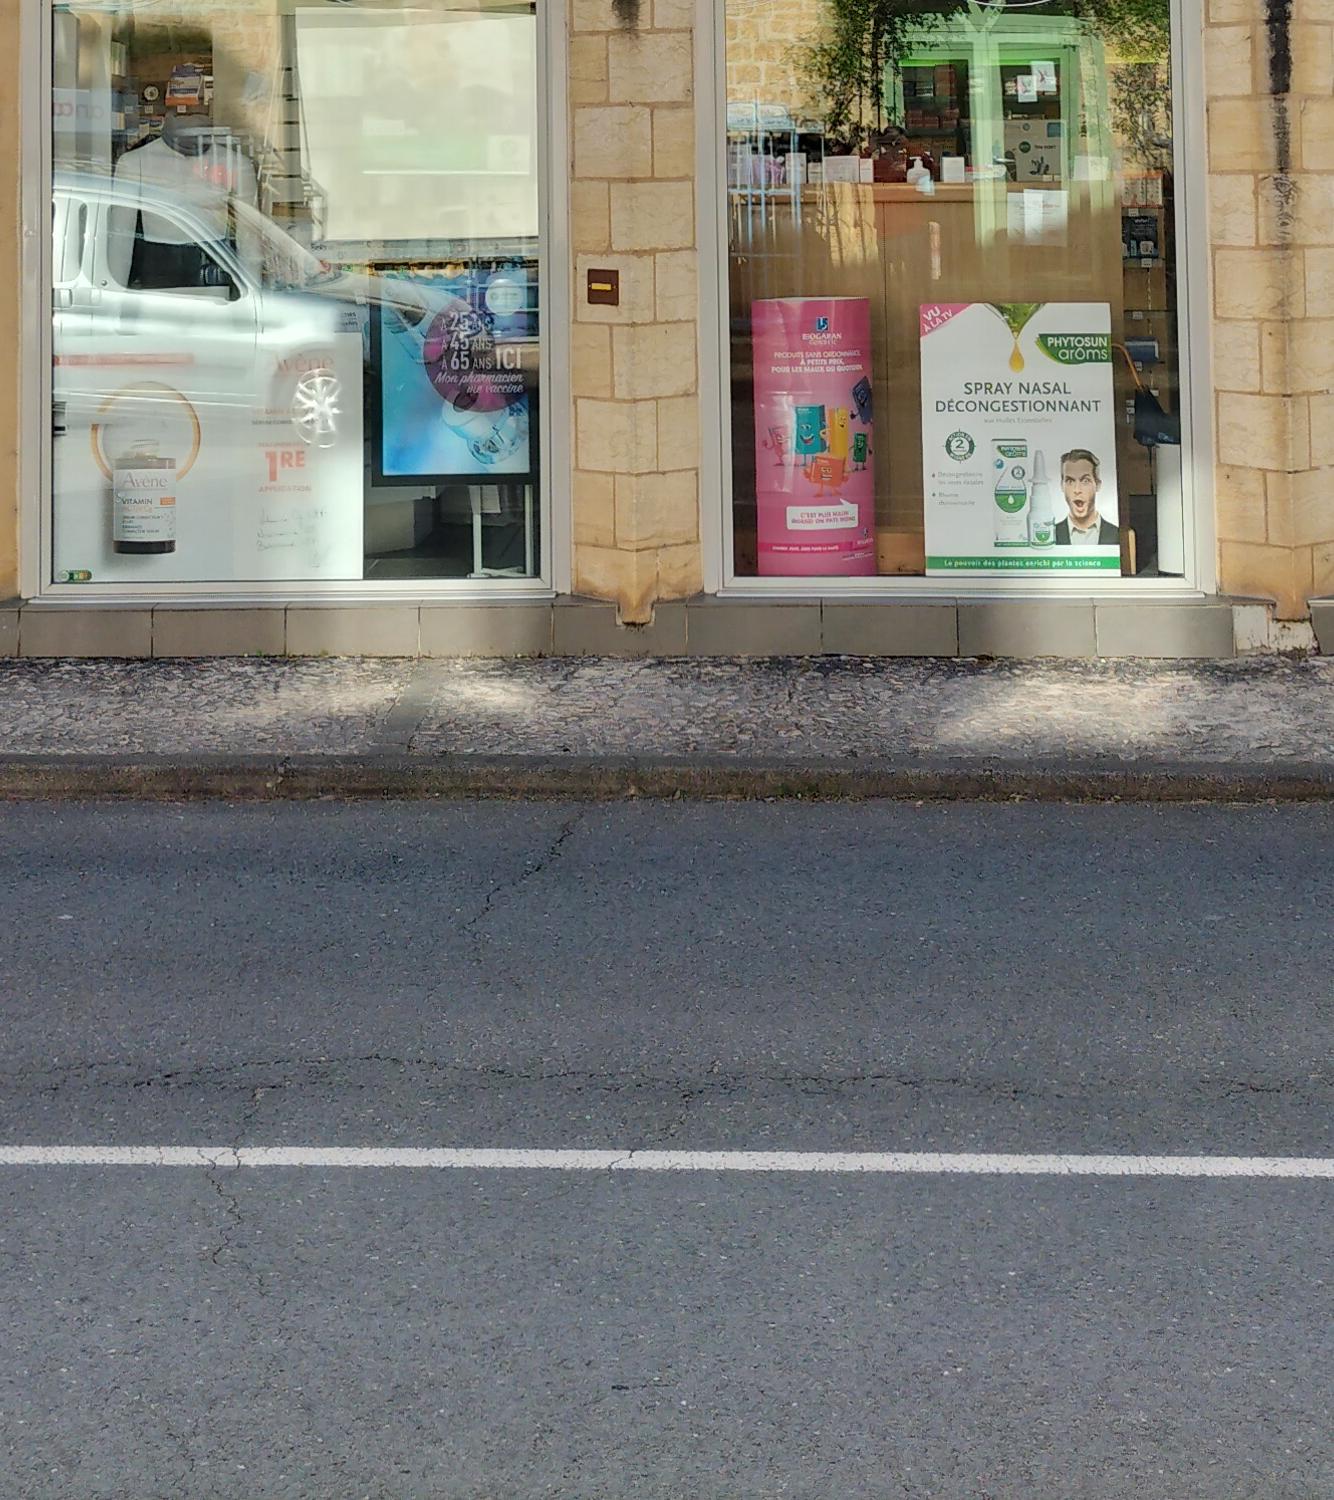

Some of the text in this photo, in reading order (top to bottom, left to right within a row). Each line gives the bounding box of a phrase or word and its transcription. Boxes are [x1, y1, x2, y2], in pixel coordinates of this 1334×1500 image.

[450, 311, 470, 331] 25
[922, 306, 941, 322] VU
[931, 316, 943, 329] LA
[942, 309, 954, 322] TV
[450, 331, 470, 350] 45
[472, 338, 492, 350] ANS
[1047, 336, 1108, 347] PHYTOSUN
[450, 351, 470, 370] 65
[472, 358, 492, 370] ANS
[496, 347, 522, 370] ICI
[1058, 348, 1108, 361] arôms
[435, 371, 524, 385] Mon pharmacien
[466, 384, 524, 394] me vaccine
[964, 382, 1071, 395] SPRAY NASAL
[935, 398, 1101, 412] DÉCONGESTIONNANT
[955, 439, 965, 449] 2
[265, 450, 305, 482] 1RE
[123, 472, 167, 488] Avène
